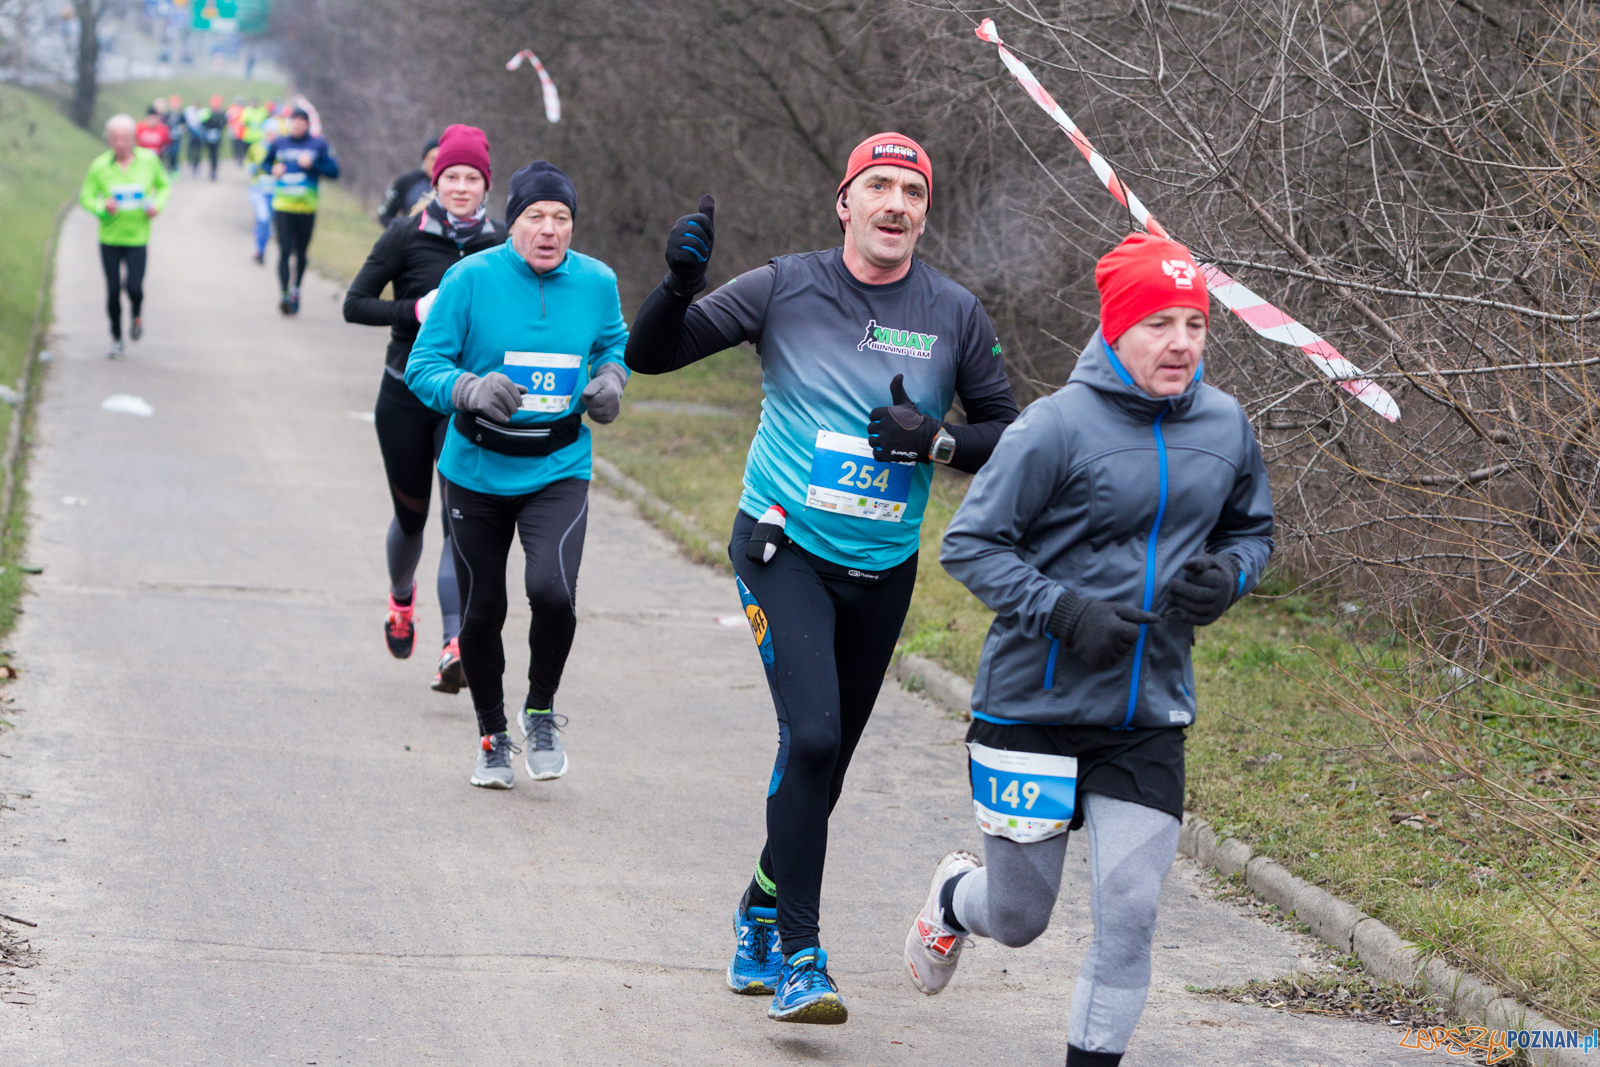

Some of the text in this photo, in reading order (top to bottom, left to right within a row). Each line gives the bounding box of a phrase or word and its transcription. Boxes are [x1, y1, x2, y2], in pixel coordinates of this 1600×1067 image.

[871, 342, 931, 358] RUNNING TEAM
[873, 327, 937, 351] MUAY
[531, 371, 556, 392] 98
[837, 460, 890, 493] 254
[988, 776, 1041, 811] 149
